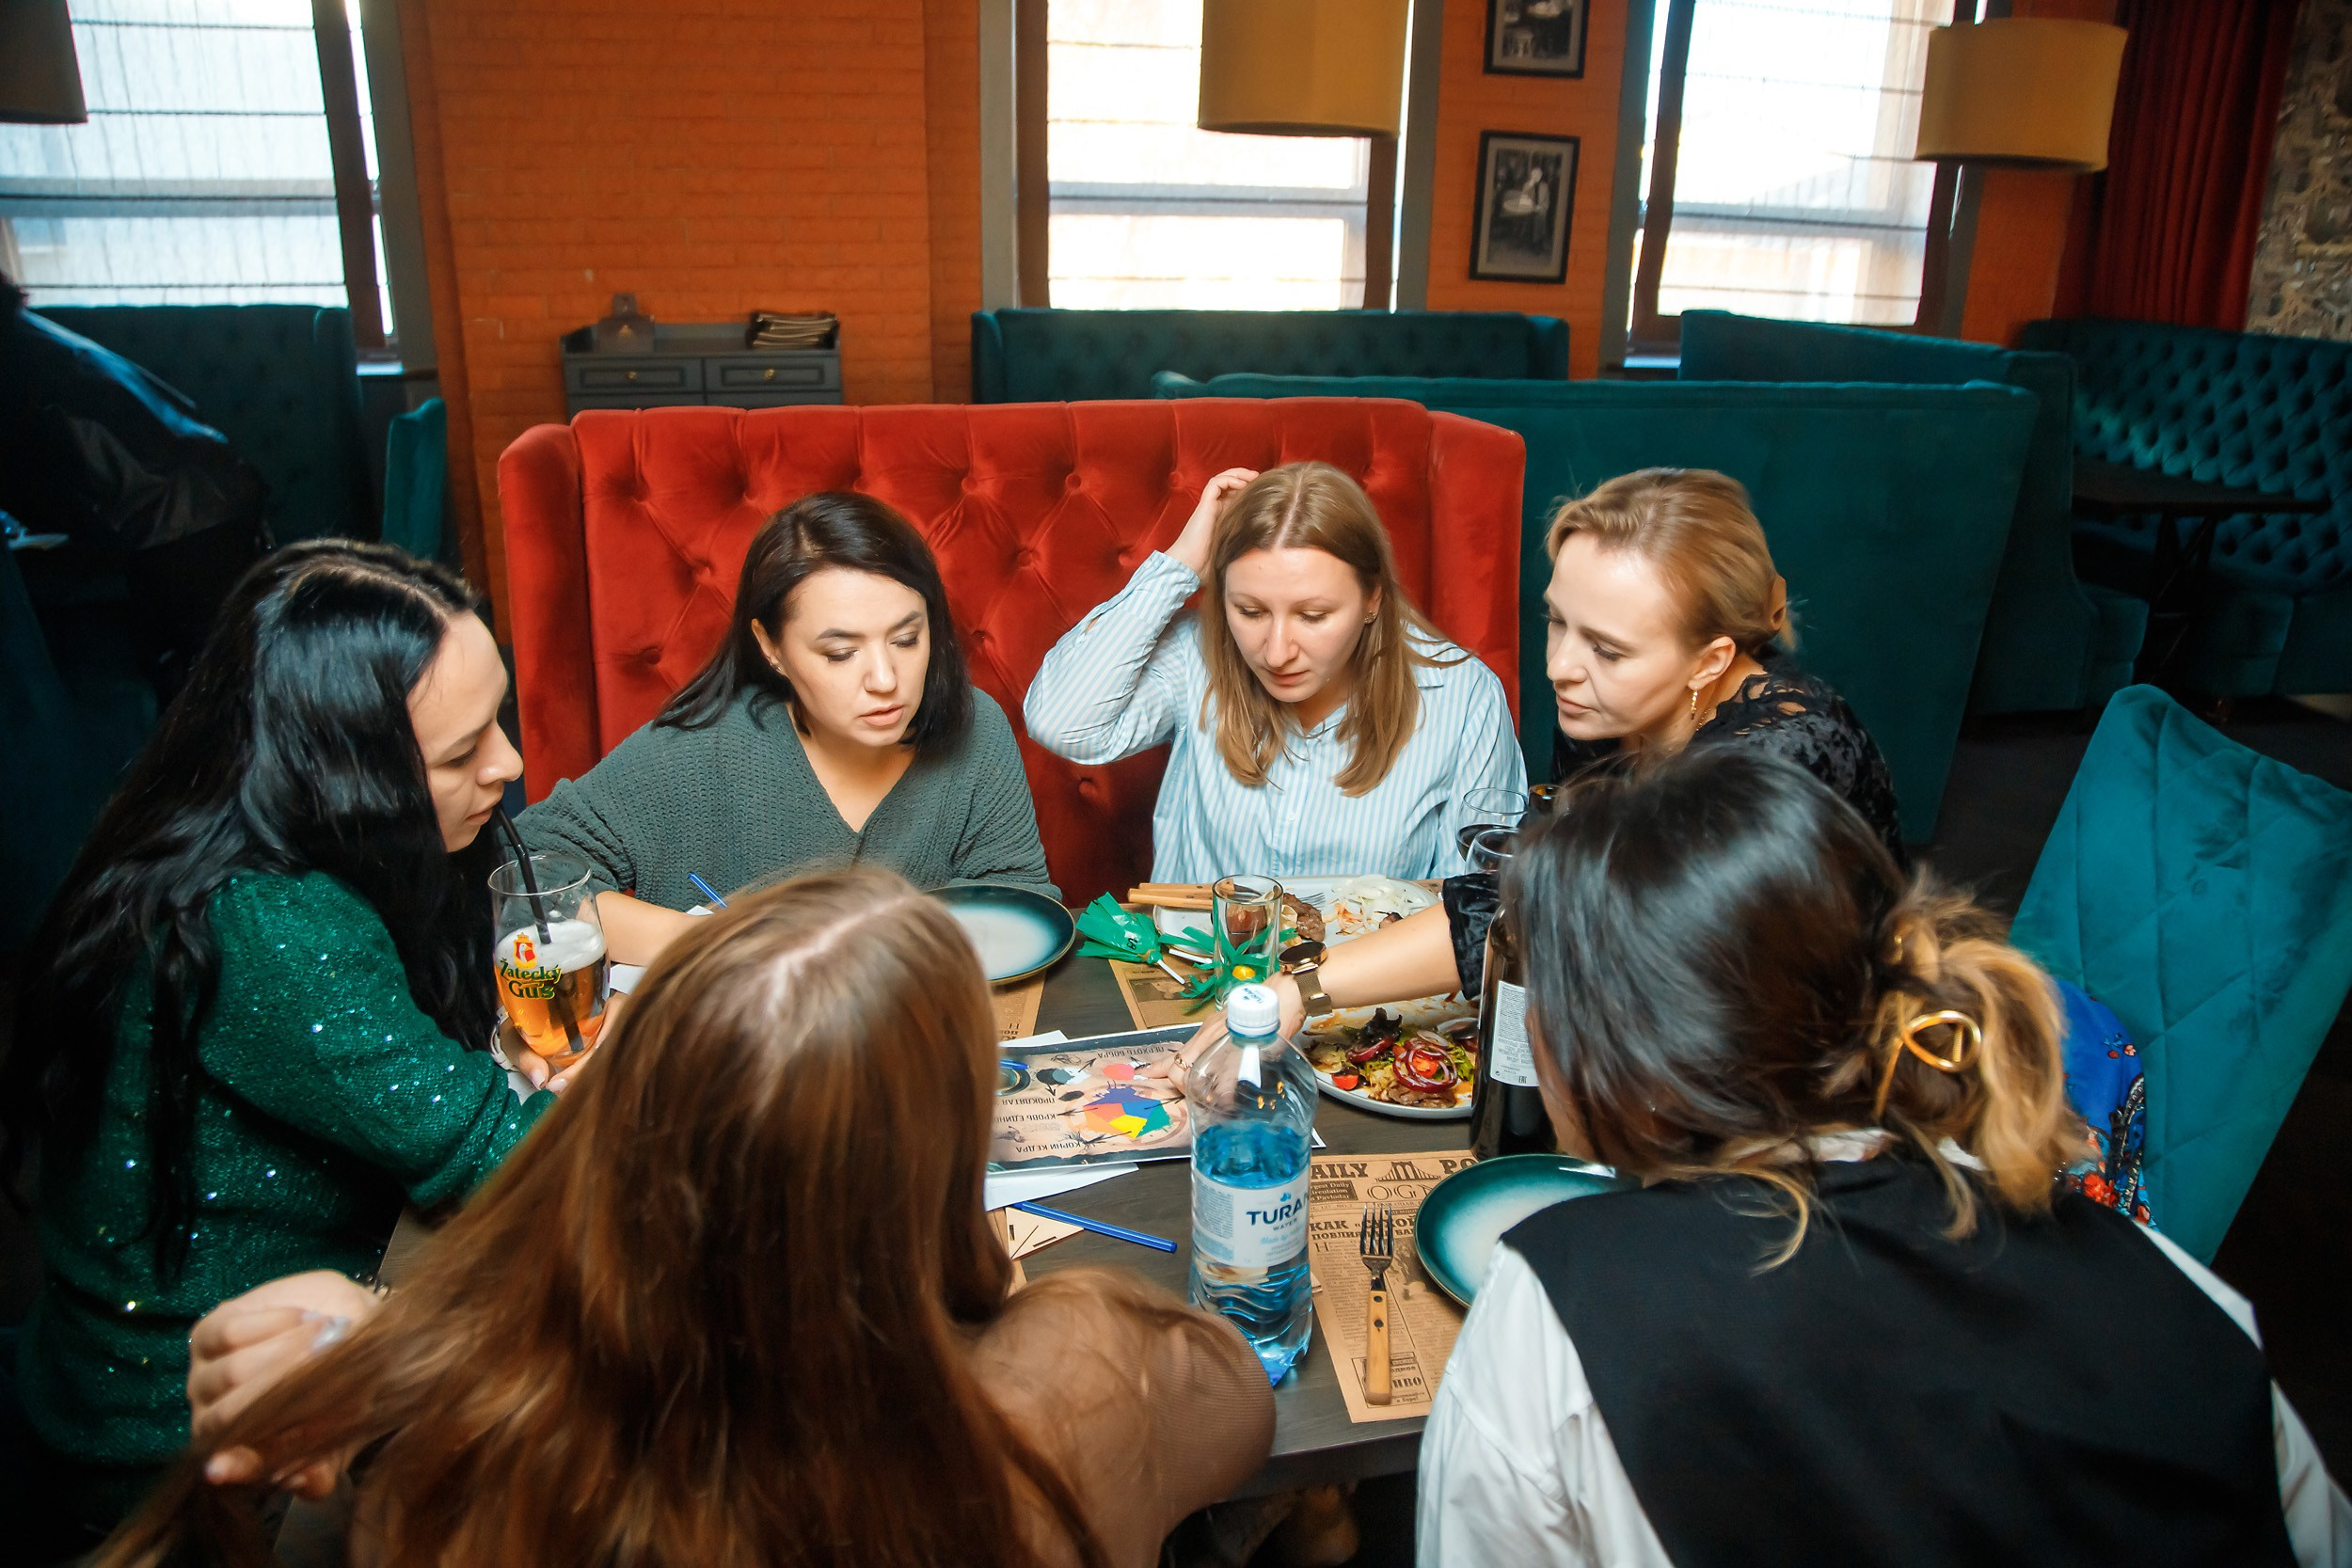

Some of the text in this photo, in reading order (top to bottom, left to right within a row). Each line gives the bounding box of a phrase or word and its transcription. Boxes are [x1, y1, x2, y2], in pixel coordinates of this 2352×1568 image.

[1097, 1046, 1165, 1059] ПЕРХОТЬ БОБРА
[1027, 1114, 1057, 1122] КРОВЬ
[1016, 1141, 1081, 1153] КОРНИ КЕДРА
[1311, 1158, 1478, 1180] AILY PO
[1310, 1220, 1349, 1232] КАК
